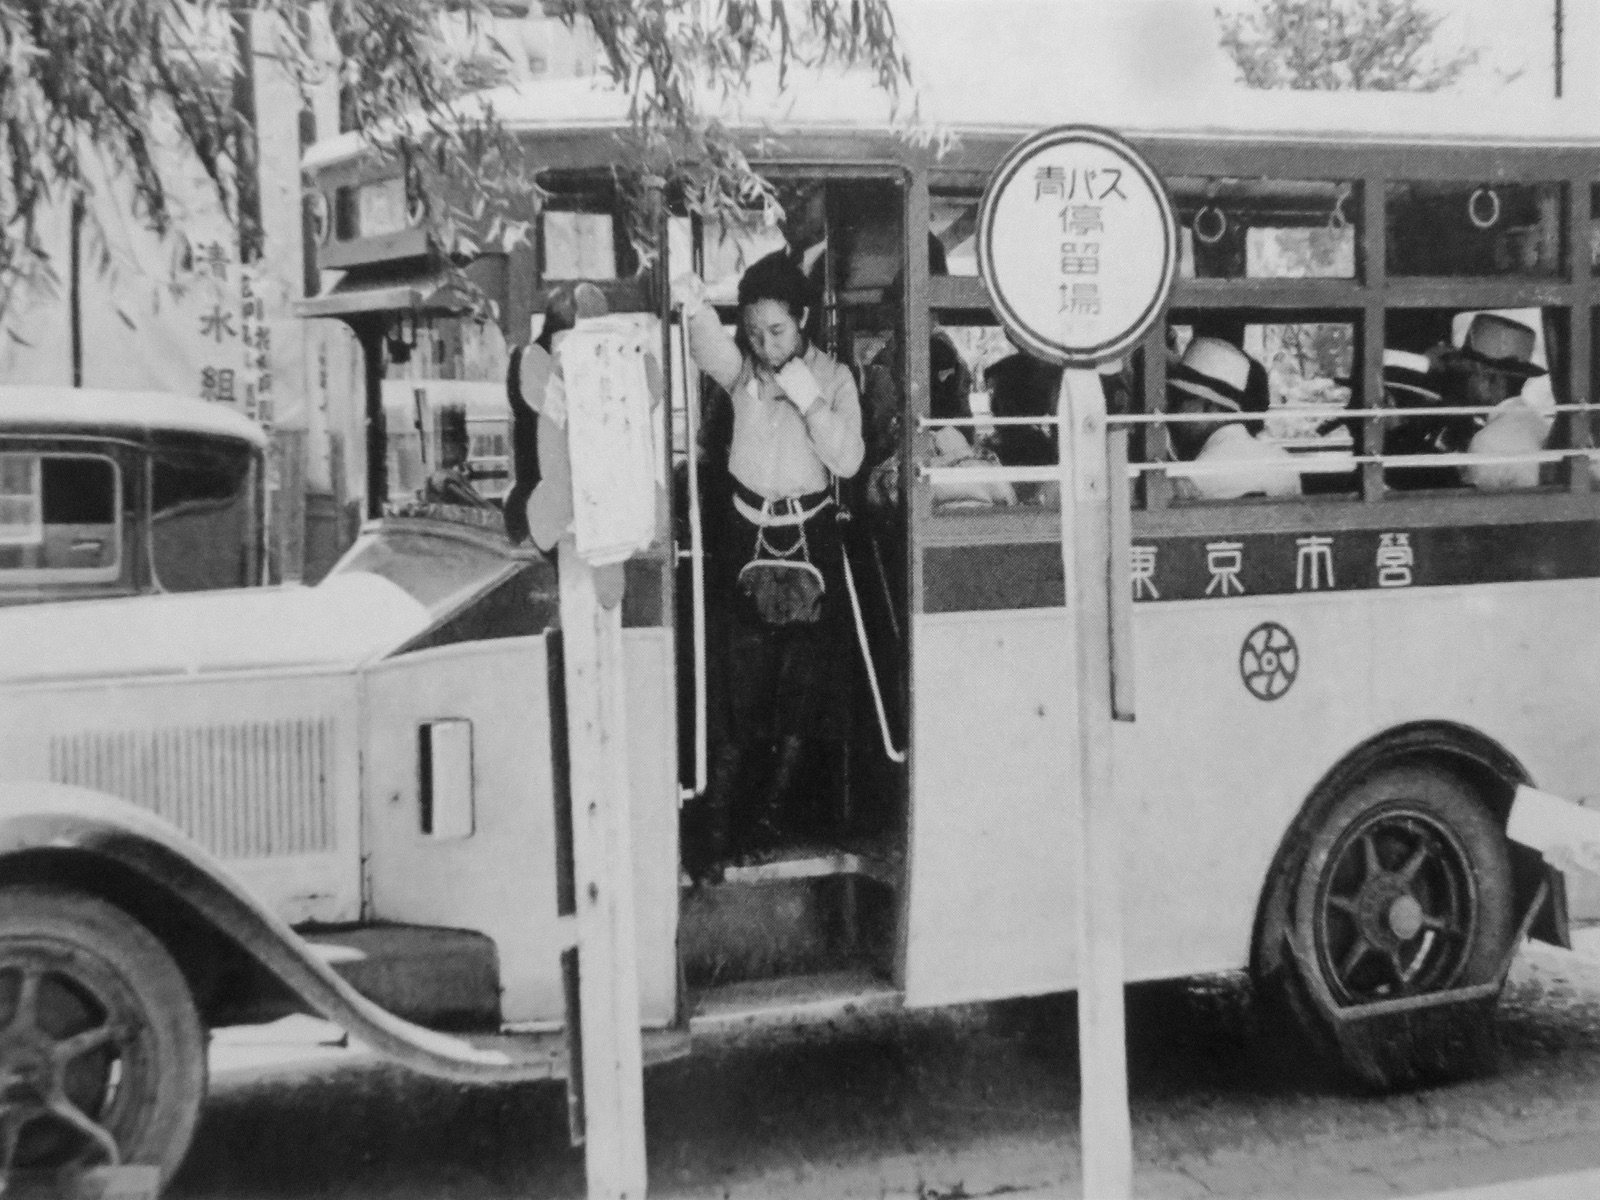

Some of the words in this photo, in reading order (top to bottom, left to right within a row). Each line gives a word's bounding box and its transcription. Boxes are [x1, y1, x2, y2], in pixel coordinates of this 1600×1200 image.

[1034, 165, 1128, 202] 青バス
[1058, 203, 1104, 315] 停留場
[195, 241, 238, 402] 清水組
